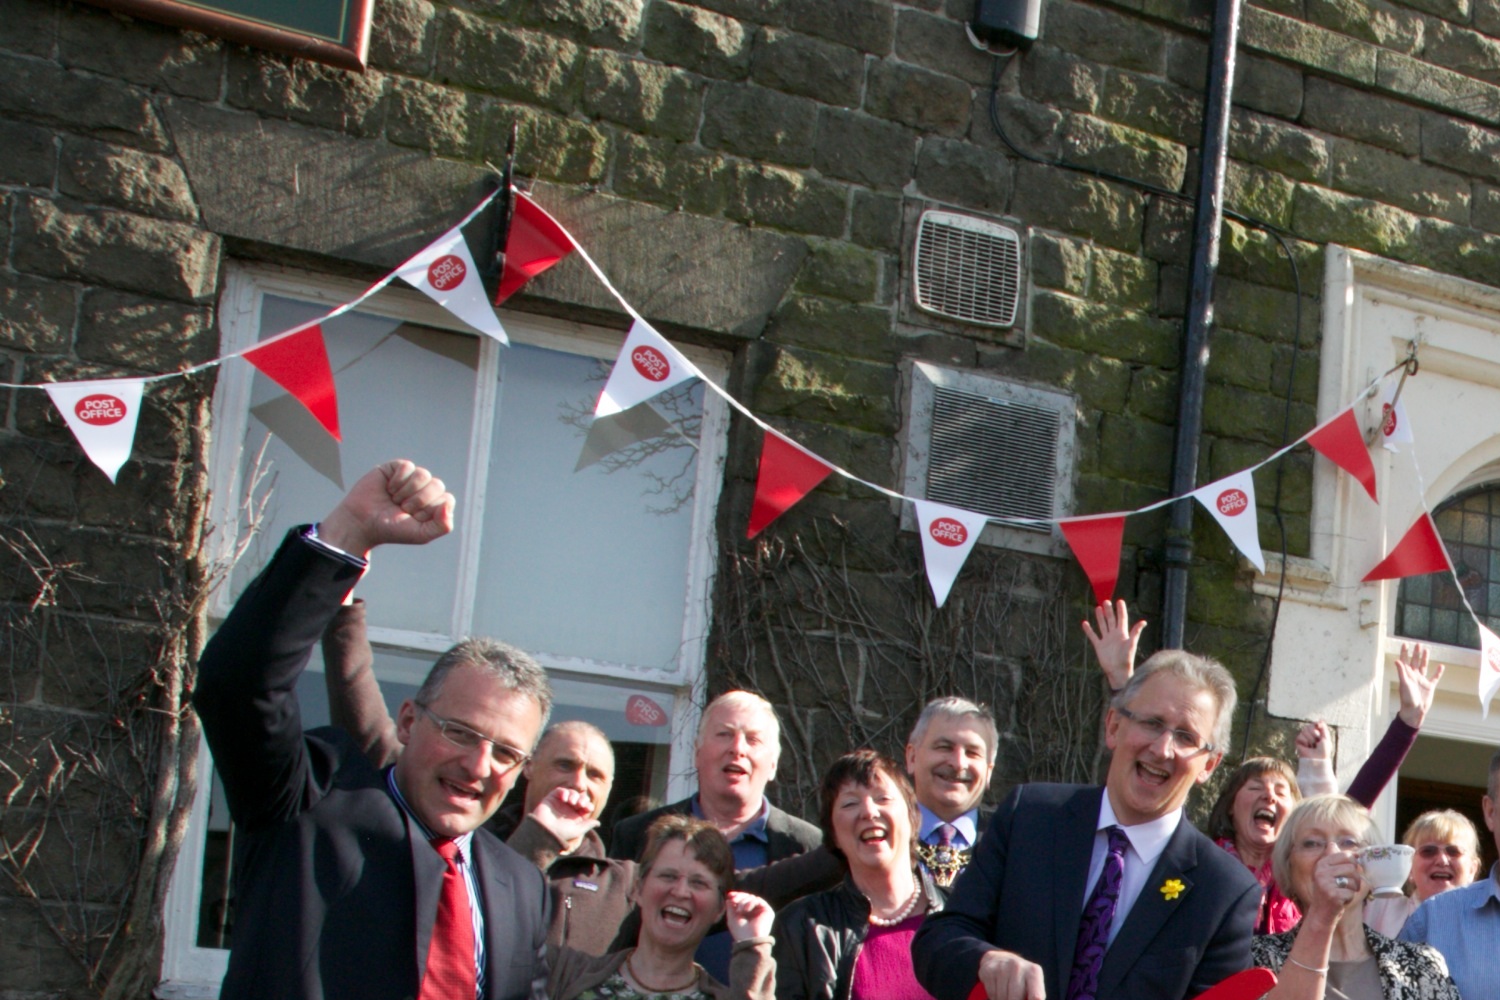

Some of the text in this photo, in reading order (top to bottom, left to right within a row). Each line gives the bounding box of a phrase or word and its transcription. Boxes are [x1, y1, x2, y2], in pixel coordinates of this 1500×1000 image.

[432, 258, 454, 278] POST
[435, 264, 464, 288] OFFICE
[634, 352, 663, 380] OFFICE
[643, 350, 667, 370] POST
[85, 399, 115, 410] POST
[80, 408, 122, 419] OFFICE
[1221, 491, 1240, 505] POST
[932, 528, 963, 543] OFFICE
[938, 521, 962, 533] POST
[633, 699, 660, 720] PRS
